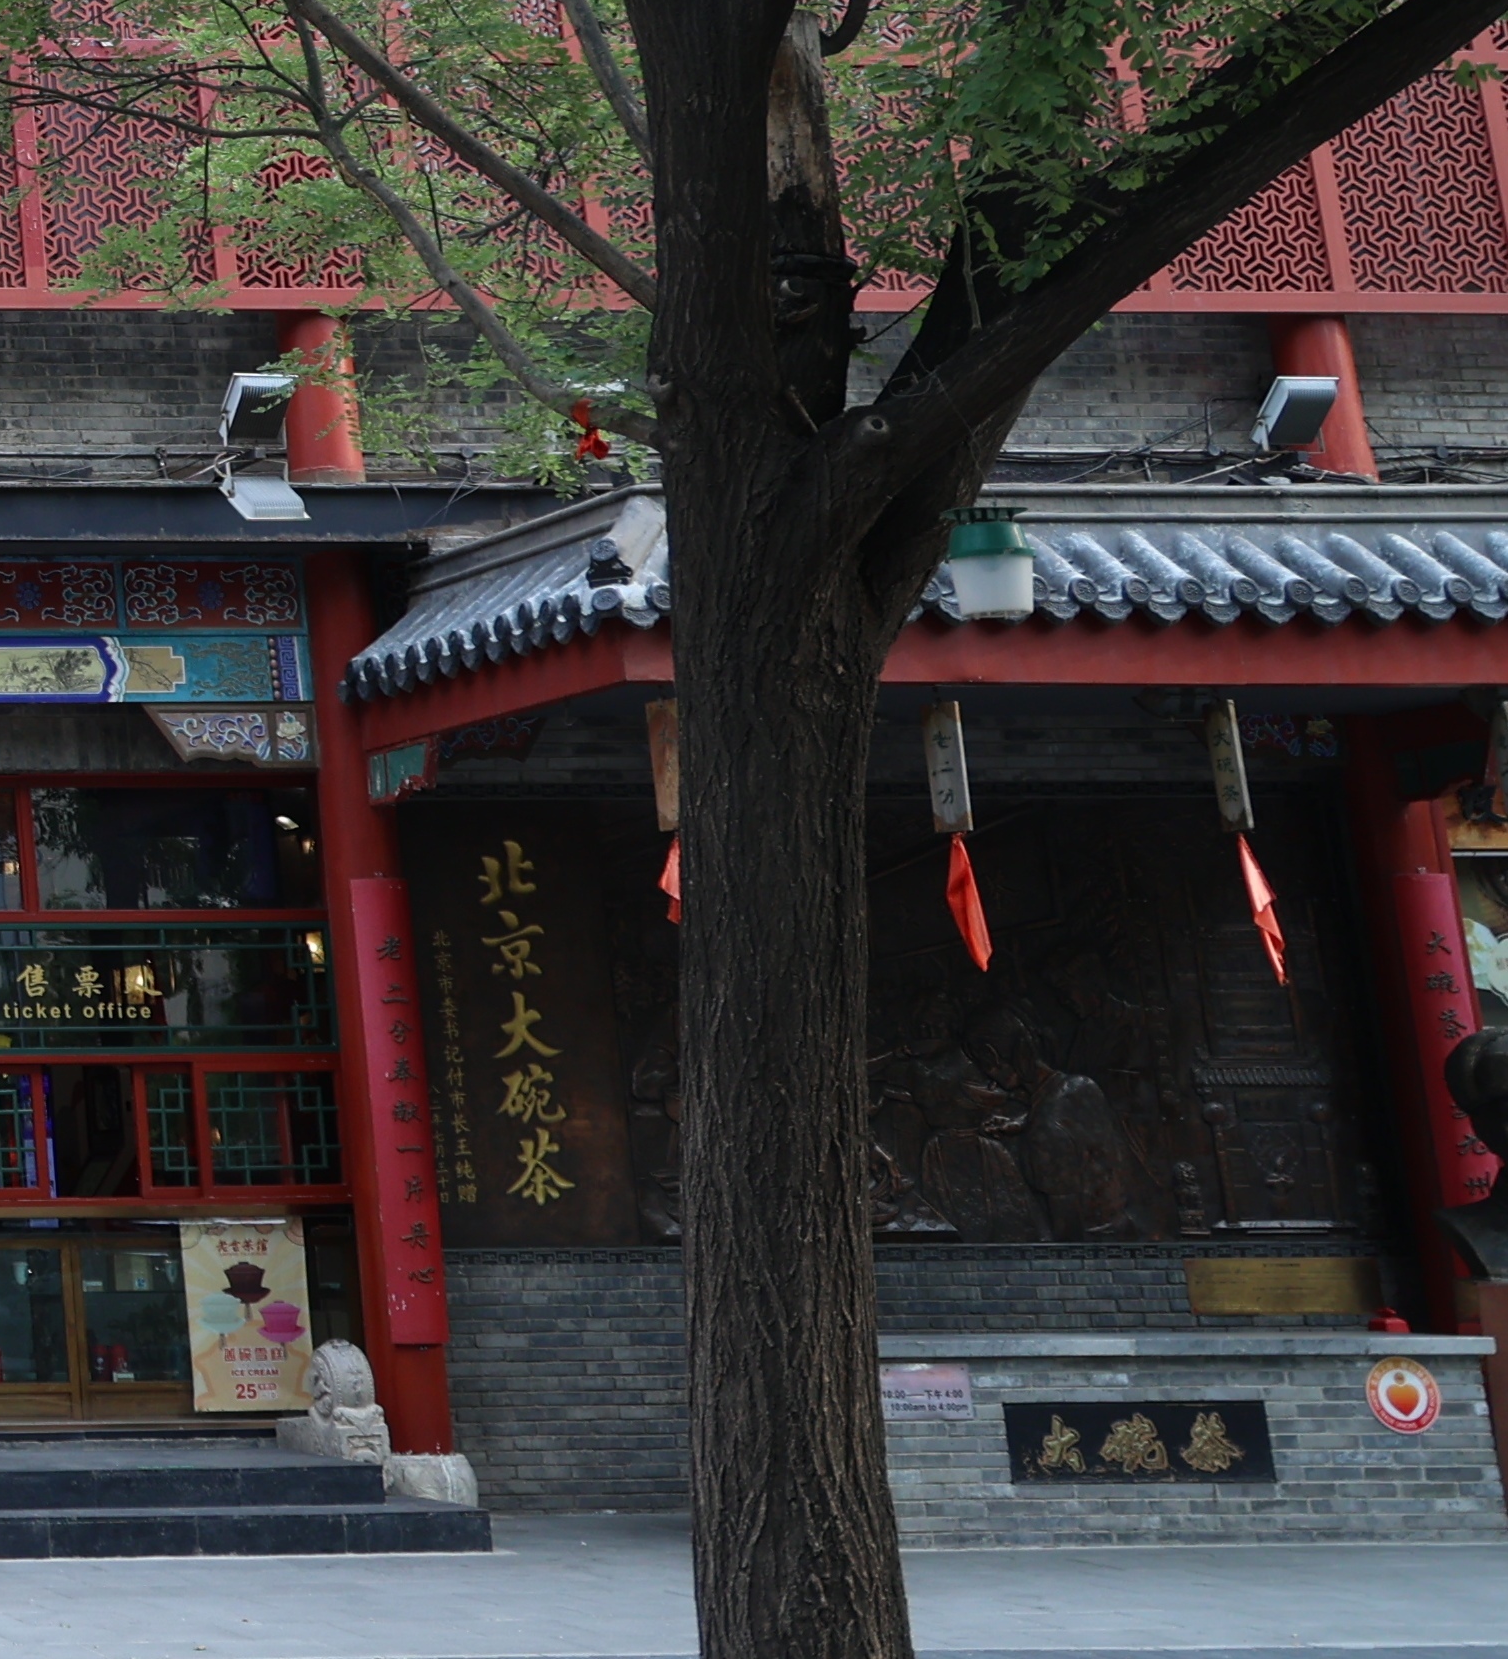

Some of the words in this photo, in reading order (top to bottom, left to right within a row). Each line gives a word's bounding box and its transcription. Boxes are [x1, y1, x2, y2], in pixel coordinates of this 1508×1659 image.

[3, 1002, 72, 1020] ticket
[83, 1002, 153, 1020] office
[479, 840, 575, 1206] 北京大碗茶
[235, 1383, 258, 1400] 25
